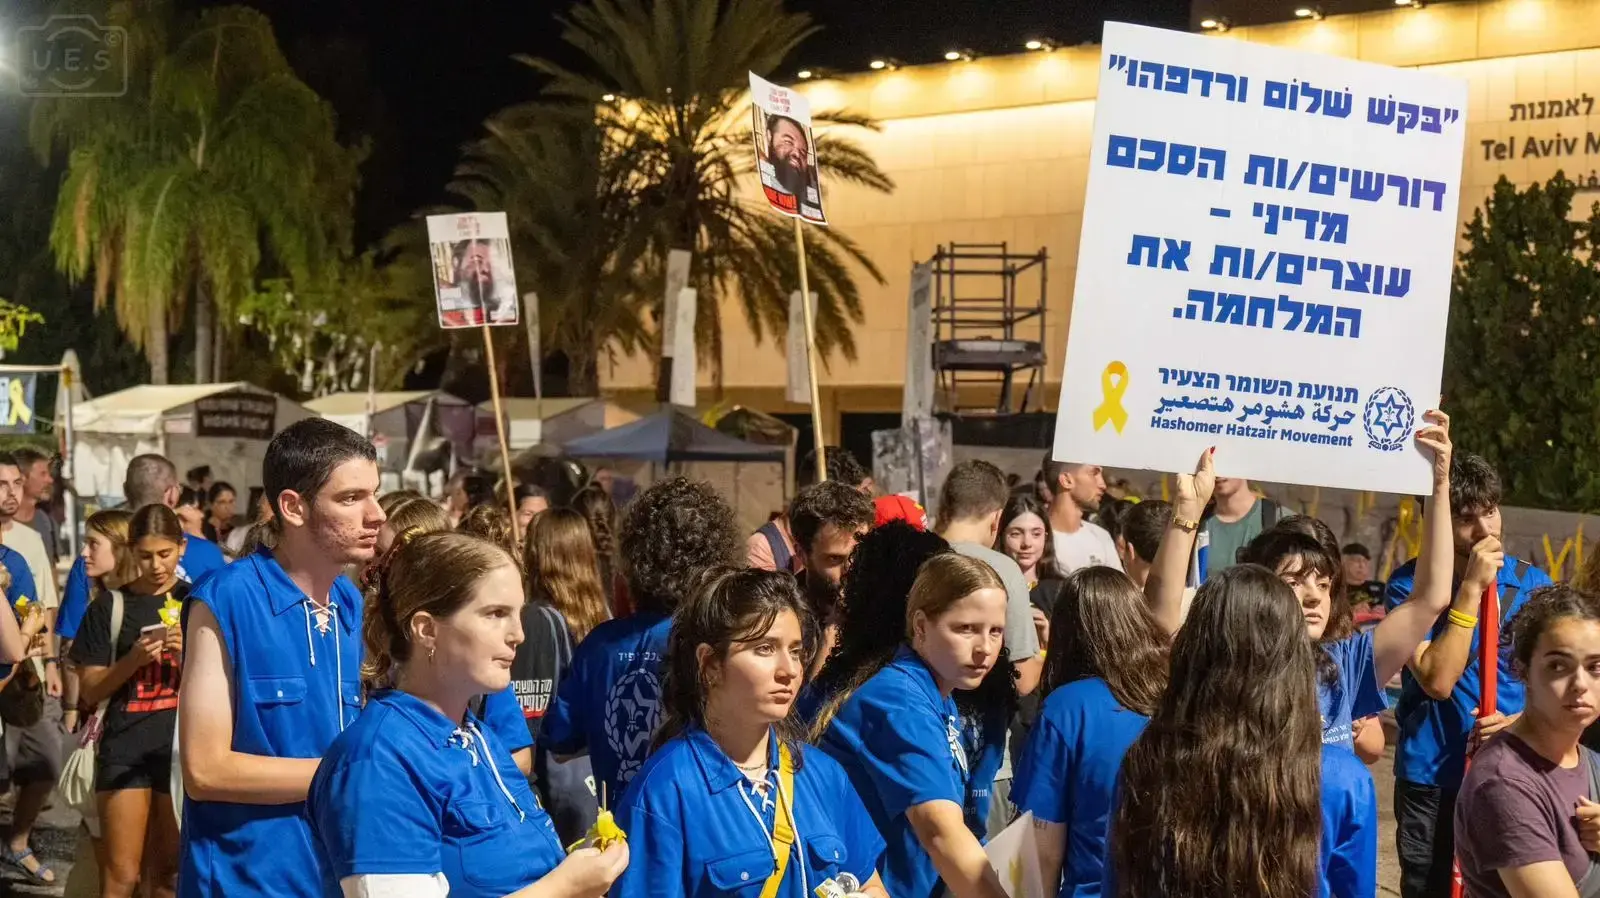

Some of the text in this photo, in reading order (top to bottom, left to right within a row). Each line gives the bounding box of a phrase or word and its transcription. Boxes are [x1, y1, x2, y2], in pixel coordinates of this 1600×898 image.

[1509, 93, 1594, 122] לאמנות
[1481, 136, 1515, 161] Tel
[1522, 133, 1579, 159] Aviv
[1106, 134, 1447, 212] דורשים/ות הסכם
[1253, 202, 1349, 244] מדיני
[1127, 234, 1412, 298] עוצרים/ות את
[1172, 289, 1362, 338] המלחמה.
[1158, 367, 1359, 404] תנועת השומר הצעיר
[1150, 415, 1224, 434] Hashomer
[1226, 423, 1278, 440] Hatzair
[1280, 428, 1353, 447] Movement
[1312, 402, 1356, 431] حركة
